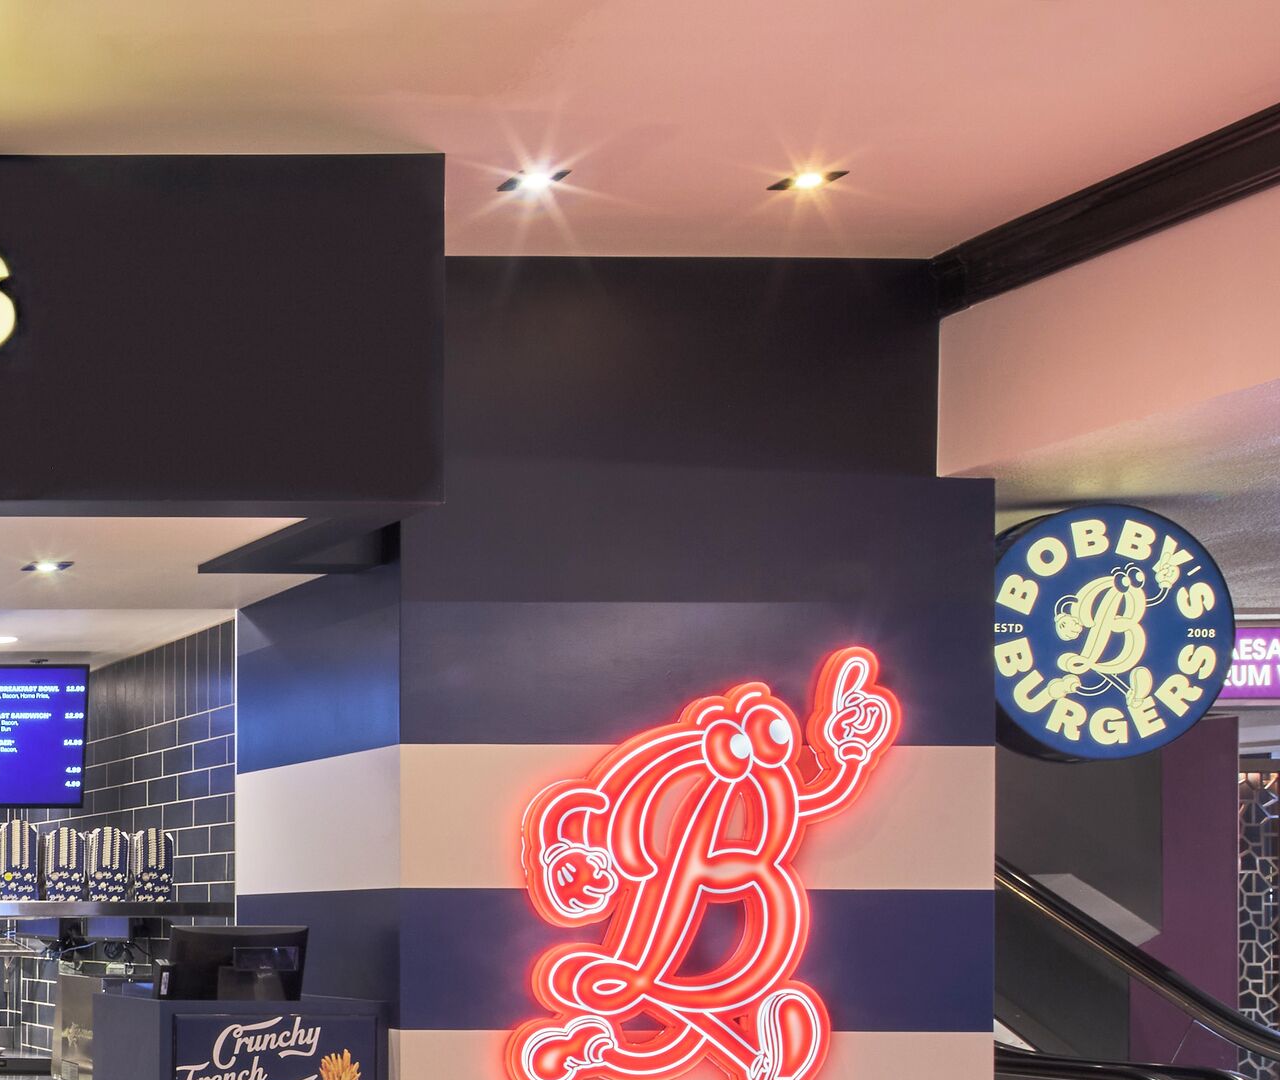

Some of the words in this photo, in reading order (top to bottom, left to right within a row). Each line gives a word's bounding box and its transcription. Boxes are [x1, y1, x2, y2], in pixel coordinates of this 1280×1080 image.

[996, 519, 1216, 619] BOBBY'S
[994, 623, 1024, 633] ESTD
[1187, 628, 1216, 638] 2008
[994, 637, 1217, 745] BURGERS
[213, 1016, 321, 1070] Crunchy
